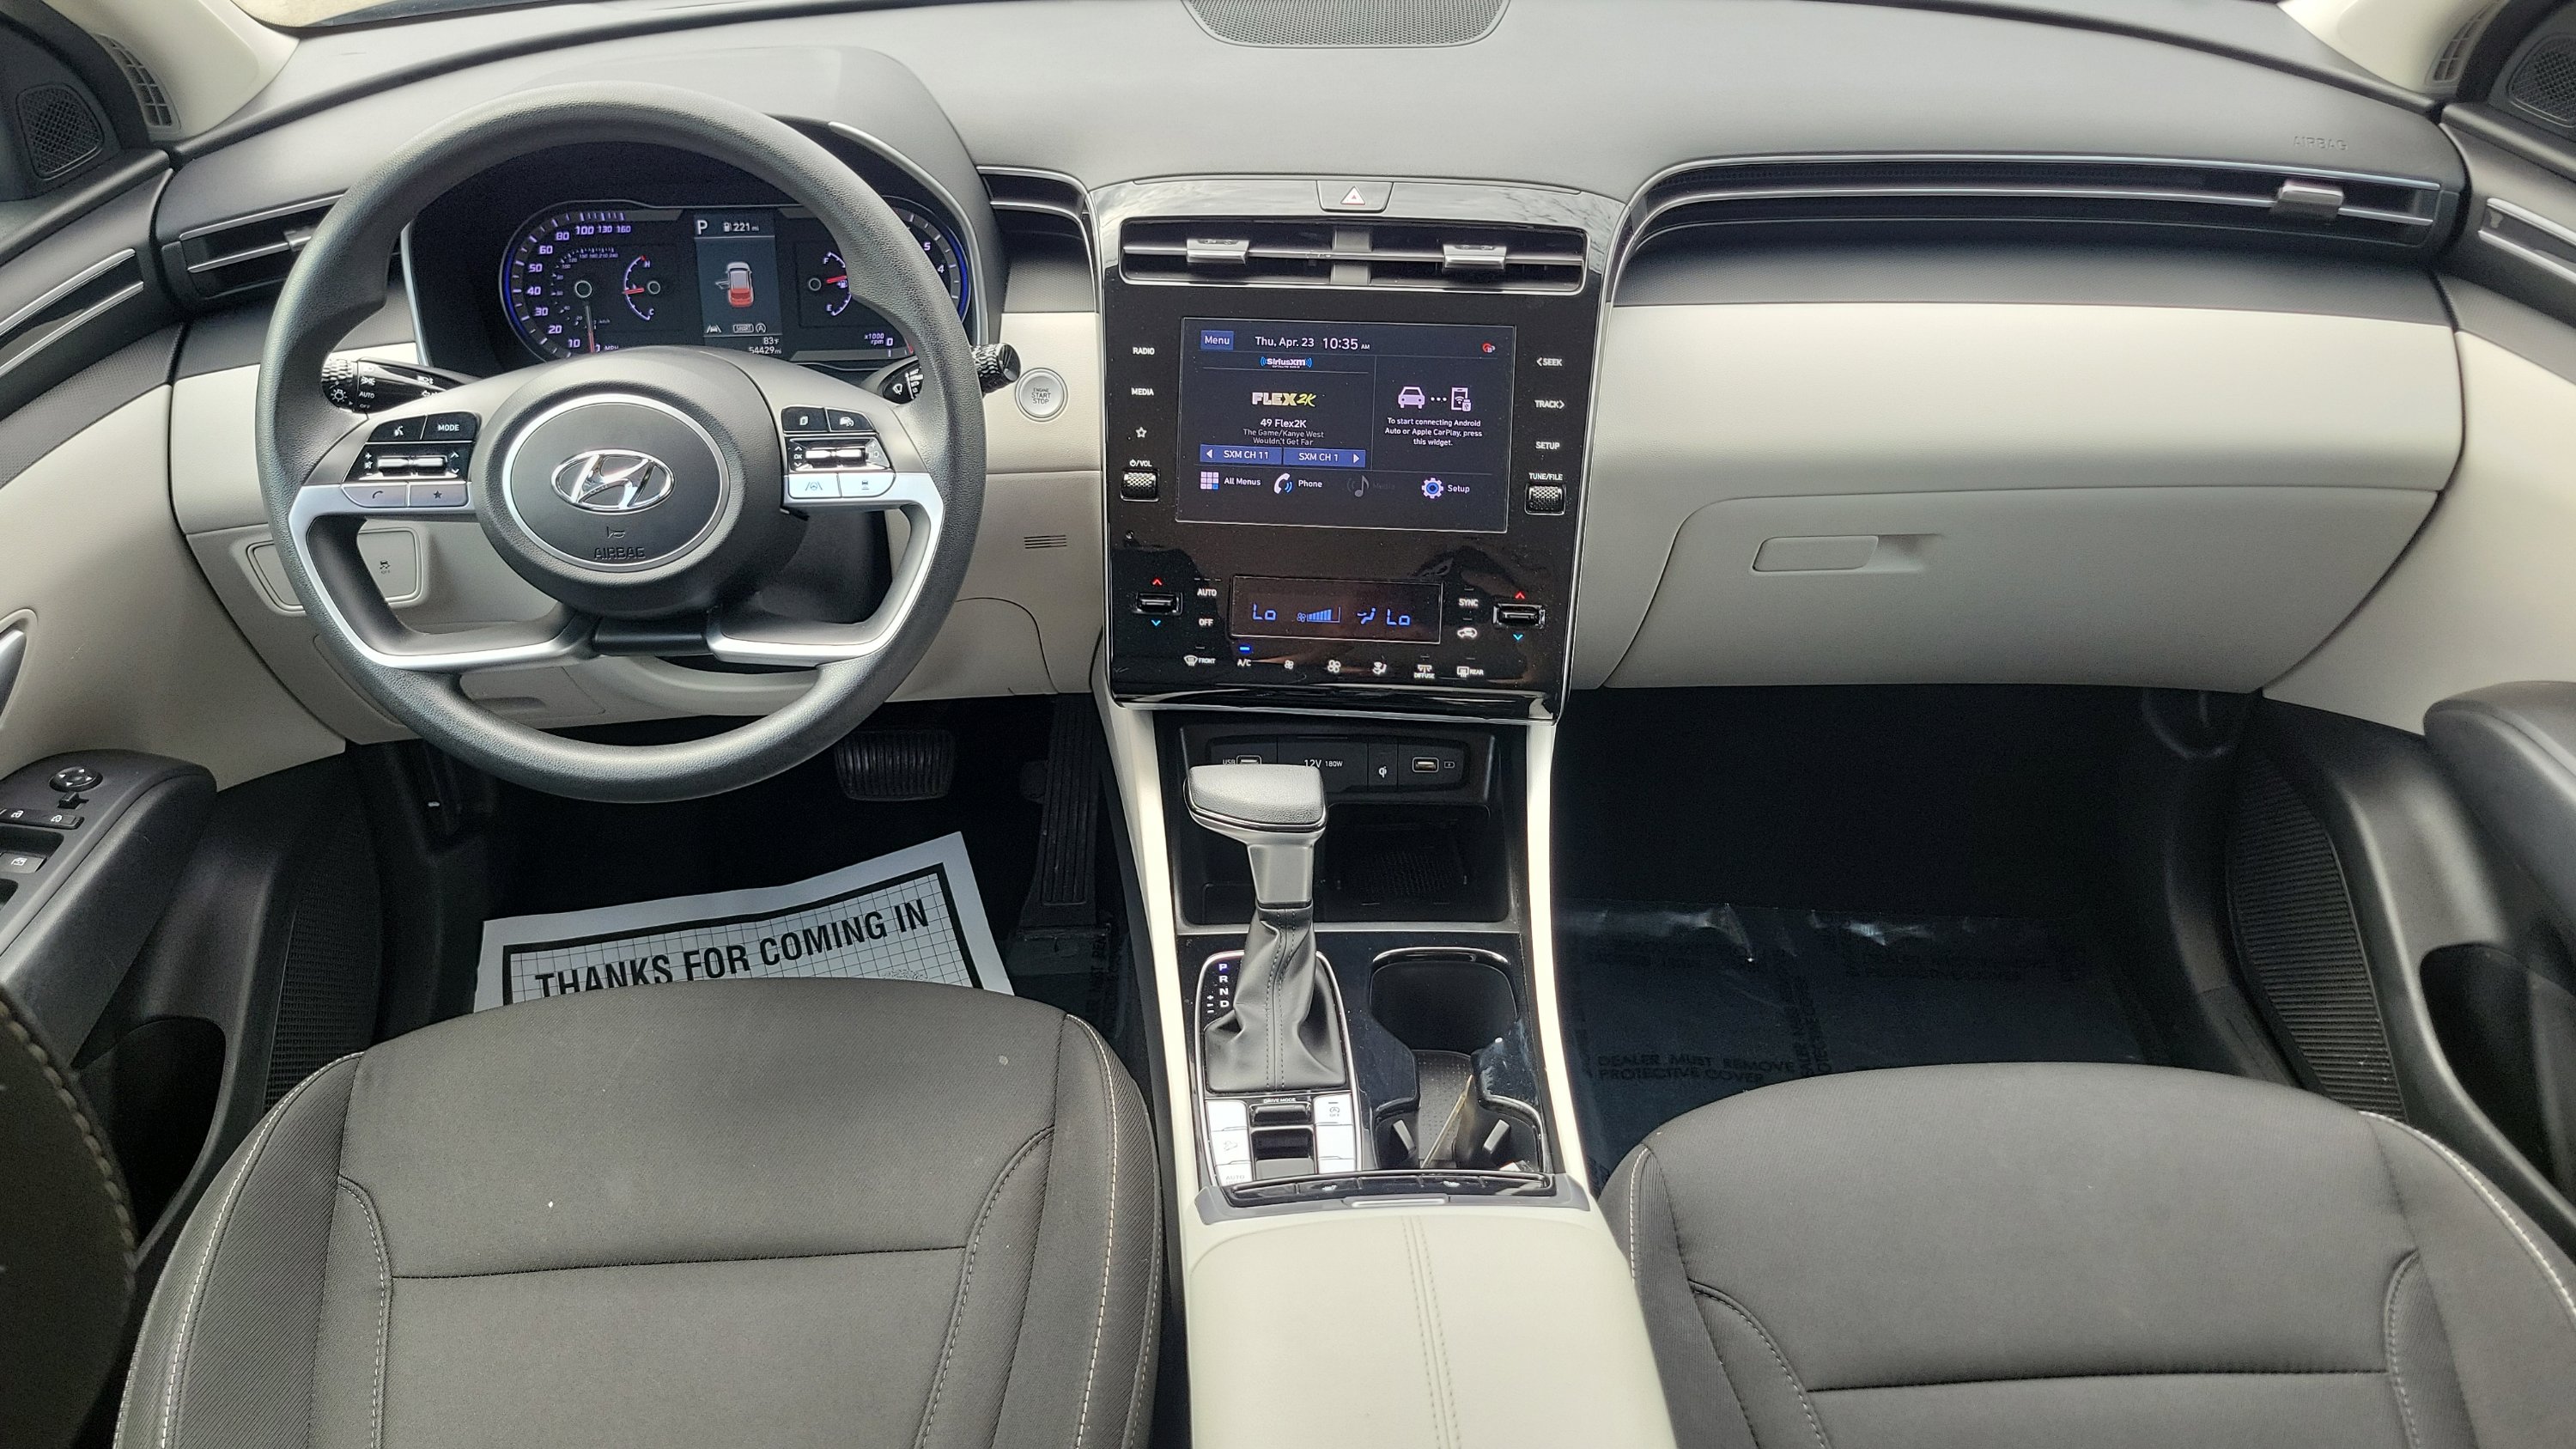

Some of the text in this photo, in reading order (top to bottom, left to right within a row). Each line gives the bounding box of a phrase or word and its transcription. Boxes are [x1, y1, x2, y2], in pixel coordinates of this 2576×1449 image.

[2292, 135, 2349, 152] AIRBAG
[575, 225, 594, 235] 100
[598, 225, 613, 234] 130
[616, 225, 631, 234] 160
[696, 219, 708, 235] P
[732, 222, 750, 232] 221
[556, 231, 570, 241] 80
[538, 245, 553, 255] 60
[923, 241, 932, 251] 5
[528, 263, 543, 273] 50
[937, 265, 945, 274] 4
[526, 286, 542, 296] 40
[533, 307, 549, 317] 30
[648, 307, 655, 316] C
[548, 325, 562, 335] 20
[568, 338, 581, 348] 10
[885, 338, 894, 346] 0
[1204, 335, 1230, 345] Menu
[1255, 336, 1277, 348] Thu,
[1279, 337, 1299, 349] Apr.
[1301, 338, 1315, 348] 23
[1322, 338, 1358, 350] 10:35
[1132, 346, 1156, 356] RADIO
[358, 391, 375, 399] AUTO
[1130, 387, 1155, 396] MEDIA
[1260, 418, 1307, 429] 49 Flex2K
[1415, 418, 1453, 428] connecting
[1258, 429, 1304, 439] Game/Kanye
[1306, 430, 1324, 439] West
[1384, 427, 1401, 435] Auto
[1412, 429, 1432, 437] Apple
[1427, 439, 1453, 447] widget.
[1535, 441, 1561, 450] SETUP
[1223, 450, 1269, 460] SXM CH 11
[1298, 453, 1317, 461] SXM
[1319, 453, 1332, 462] CH
[1224, 477, 1261, 486] All Menus
[1528, 472, 1564, 481] TUNE/FILE
[1298, 479, 1323, 488] Phone
[1447, 484, 1471, 494] Setup
[593, 546, 647, 560] AIRBAG
[1196, 588, 1218, 597] AUTO
[1458, 598, 1479, 607] SYNC
[1252, 603, 1278, 621] Lo
[1386, 608, 1412, 626] Lo
[1198, 618, 1214, 627] OFF
[1236, 658, 1252, 667] A/C
[1304, 759, 1322, 768] 12V
[535, 898, 929, 998] THANKS FOR COMING IN
[1218, 963, 1228, 971] P
[1218, 975, 1229, 983] R
[1219, 987, 1229, 995] N
[1219, 1000, 1230, 1008] D
